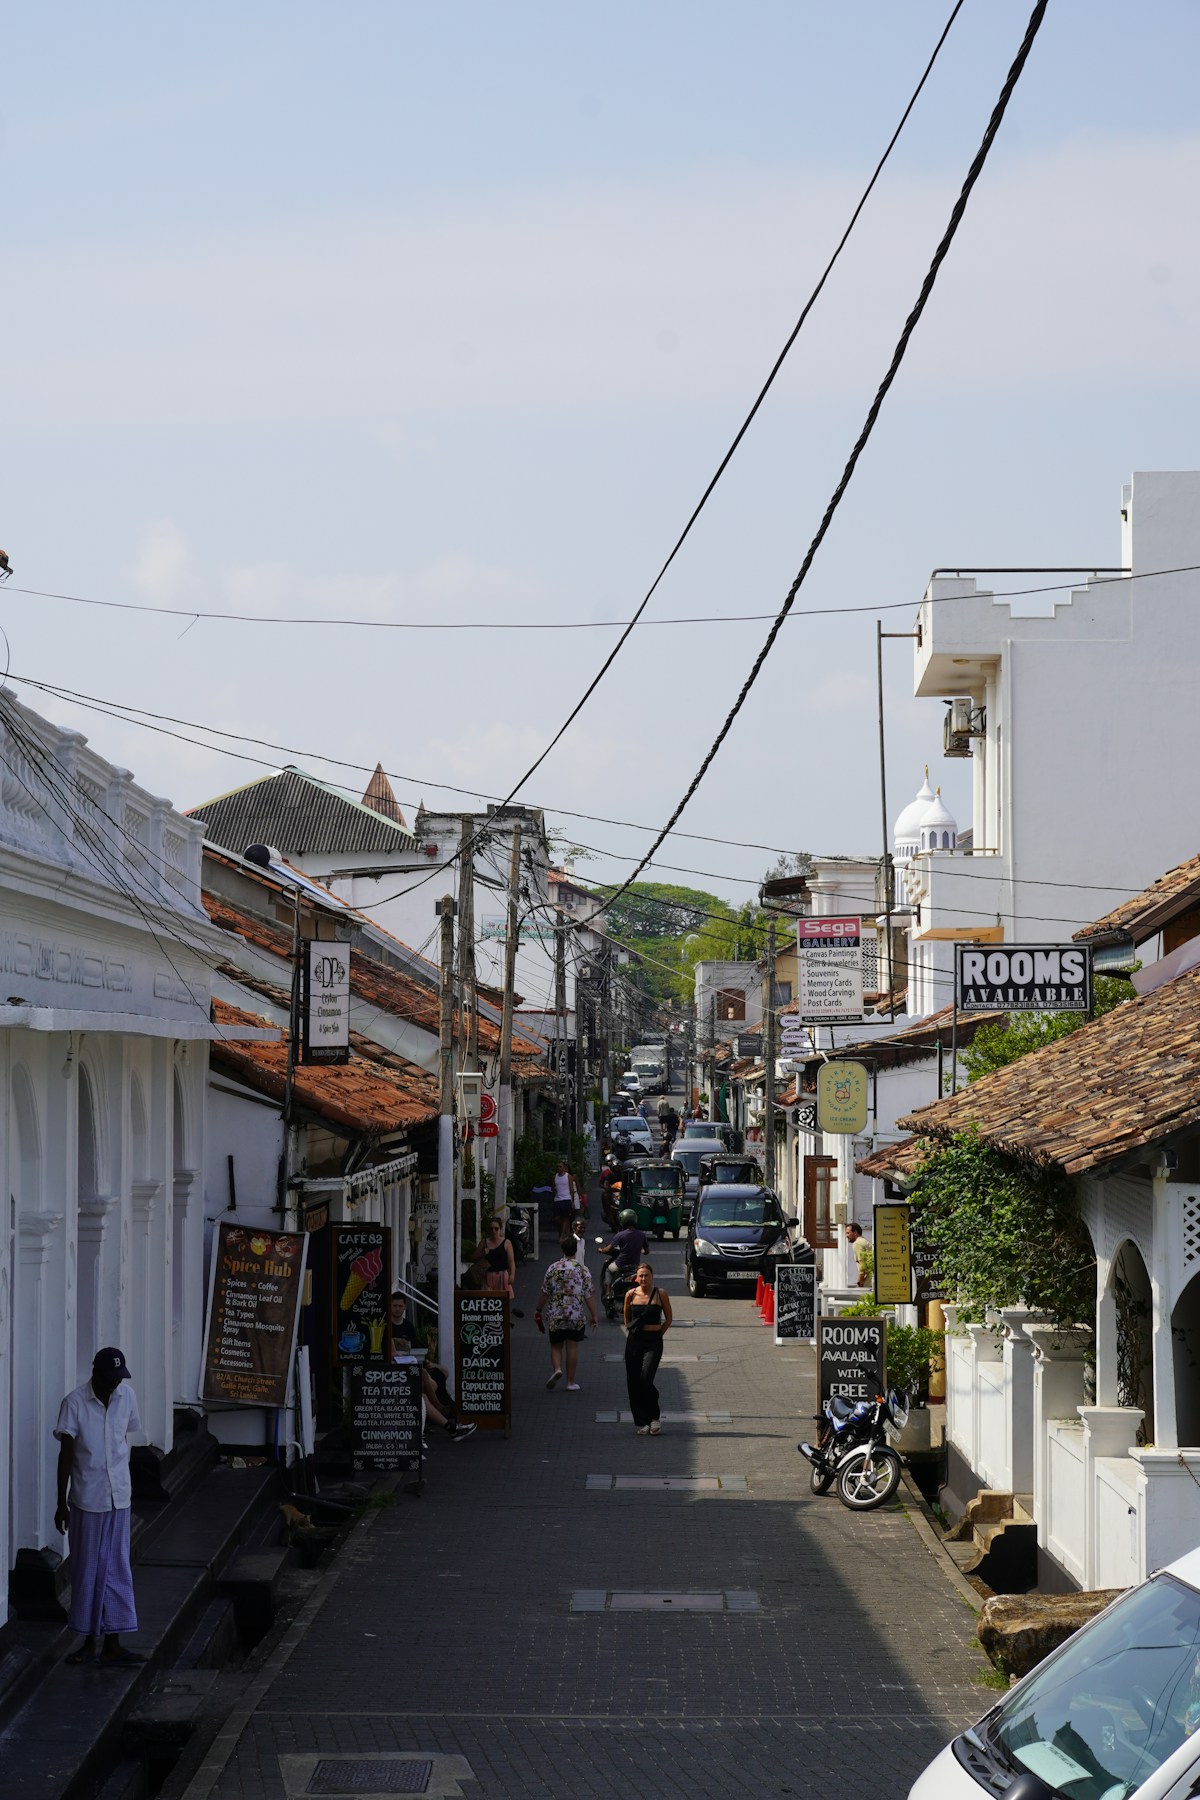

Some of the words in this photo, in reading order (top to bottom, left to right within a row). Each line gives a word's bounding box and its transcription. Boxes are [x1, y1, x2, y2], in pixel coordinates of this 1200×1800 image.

[803, 920, 857, 937] Sega
[803, 938, 857, 948] GALLERY
[806, 950, 827, 959] Canvas
[829, 949, 857, 959] Paintings
[807, 969, 839, 978] Souvenirs
[963, 950, 1085, 986] ROOMS
[807, 979, 833, 989] Memory
[834, 978, 852, 987] Cards
[808, 989, 826, 998] Wood
[828, 988, 856, 999] Carvings
[966, 987, 1083, 1003] AVAILABLE
[808, 999, 822, 1008] Post
[824, 998, 842, 1007] Cards
[338, 1232, 368, 1245] CAFÉ
[369, 1233, 383, 1245] 82
[223, 1255, 261, 1277] Spice
[264, 1259, 294, 1279] Hub
[226, 1278, 248, 1289] Spices
[257, 1281, 279, 1292] Coffee
[225, 1289, 257, 1301] Cinnamon
[259, 1292, 273, 1303] Leaf
[274, 1295, 283, 1304] Oil
[362, 1290, 382, 1302] Dairy
[232, 1299, 246, 1307] Bark
[247, 1300, 257, 1309] Oil
[359, 1297, 378, 1307] Vegan
[461, 1298, 487, 1311] CAFÉ
[488, 1299, 502, 1311] 82
[224, 1307, 235, 1317] Tea
[236, 1308, 255, 1320] Types
[352, 1304, 370, 1316] Sugar
[462, 1312, 481, 1322] Home
[482, 1312, 503, 1322] made
[222, 1325, 240, 1336] Spray
[223, 1317, 255, 1329] Cinnamon
[255, 1321, 285, 1333] Mosquito
[822, 1327, 880, 1346] ROOMS
[221, 1337, 232, 1346] Gift
[233, 1337, 251, 1348] Items
[220, 1347, 250, 1358] Cosmetics
[472, 1345, 480, 1355] &
[113, 1357, 121, 1367] B
[370, 1353, 384, 1361] JUICE
[463, 1357, 500, 1368] DAIRY
[219, 1357, 254, 1369] Accessories
[365, 1370, 407, 1383] SPICES
[462, 1370, 477, 1380] Ice
[478, 1368, 504, 1380] Cream
[234, 1374, 255, 1386] Church
[220, 1381, 235, 1391] Galle
[362, 1386, 380, 1396] TEA
[382, 1386, 411, 1396] TYPES
[461, 1380, 504, 1392] Cappuccino
[829, 1383, 868, 1398] FREE
[462, 1391, 501, 1402] Espresso
[462, 1401, 501, 1412] Smoothie
[361, 1430, 413, 1441] CINNAMON
